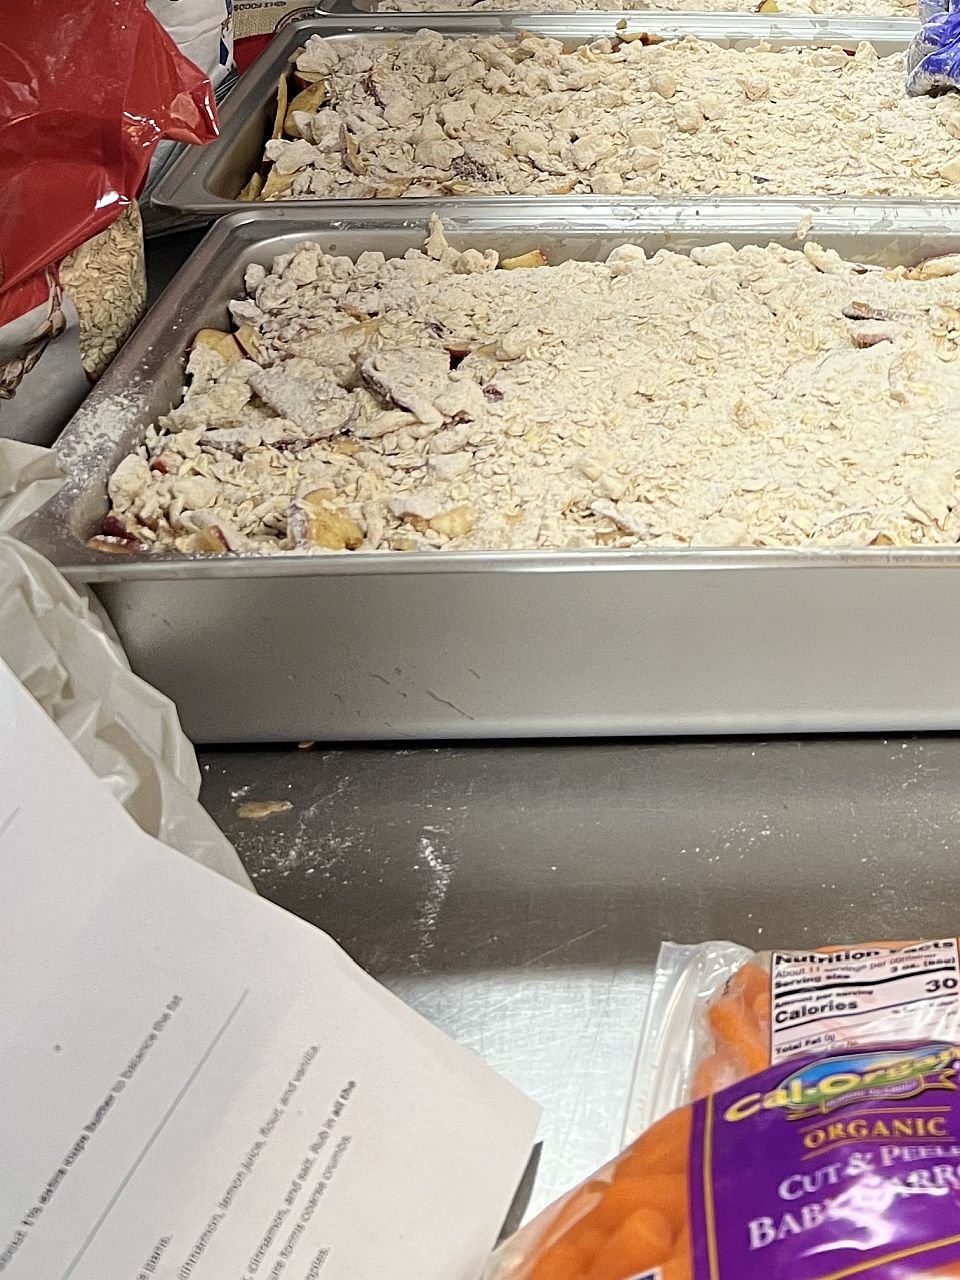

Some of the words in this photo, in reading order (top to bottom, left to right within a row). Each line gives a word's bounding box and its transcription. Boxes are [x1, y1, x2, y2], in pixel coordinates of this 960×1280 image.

[775, 1001, 859, 1024] Calories
[925, 977, 959, 994] 30
[803, 1116, 947, 1149] ORGANIC
[778, 1162, 842, 1201] CUT
[748, 1202, 829, 1250] BAB
